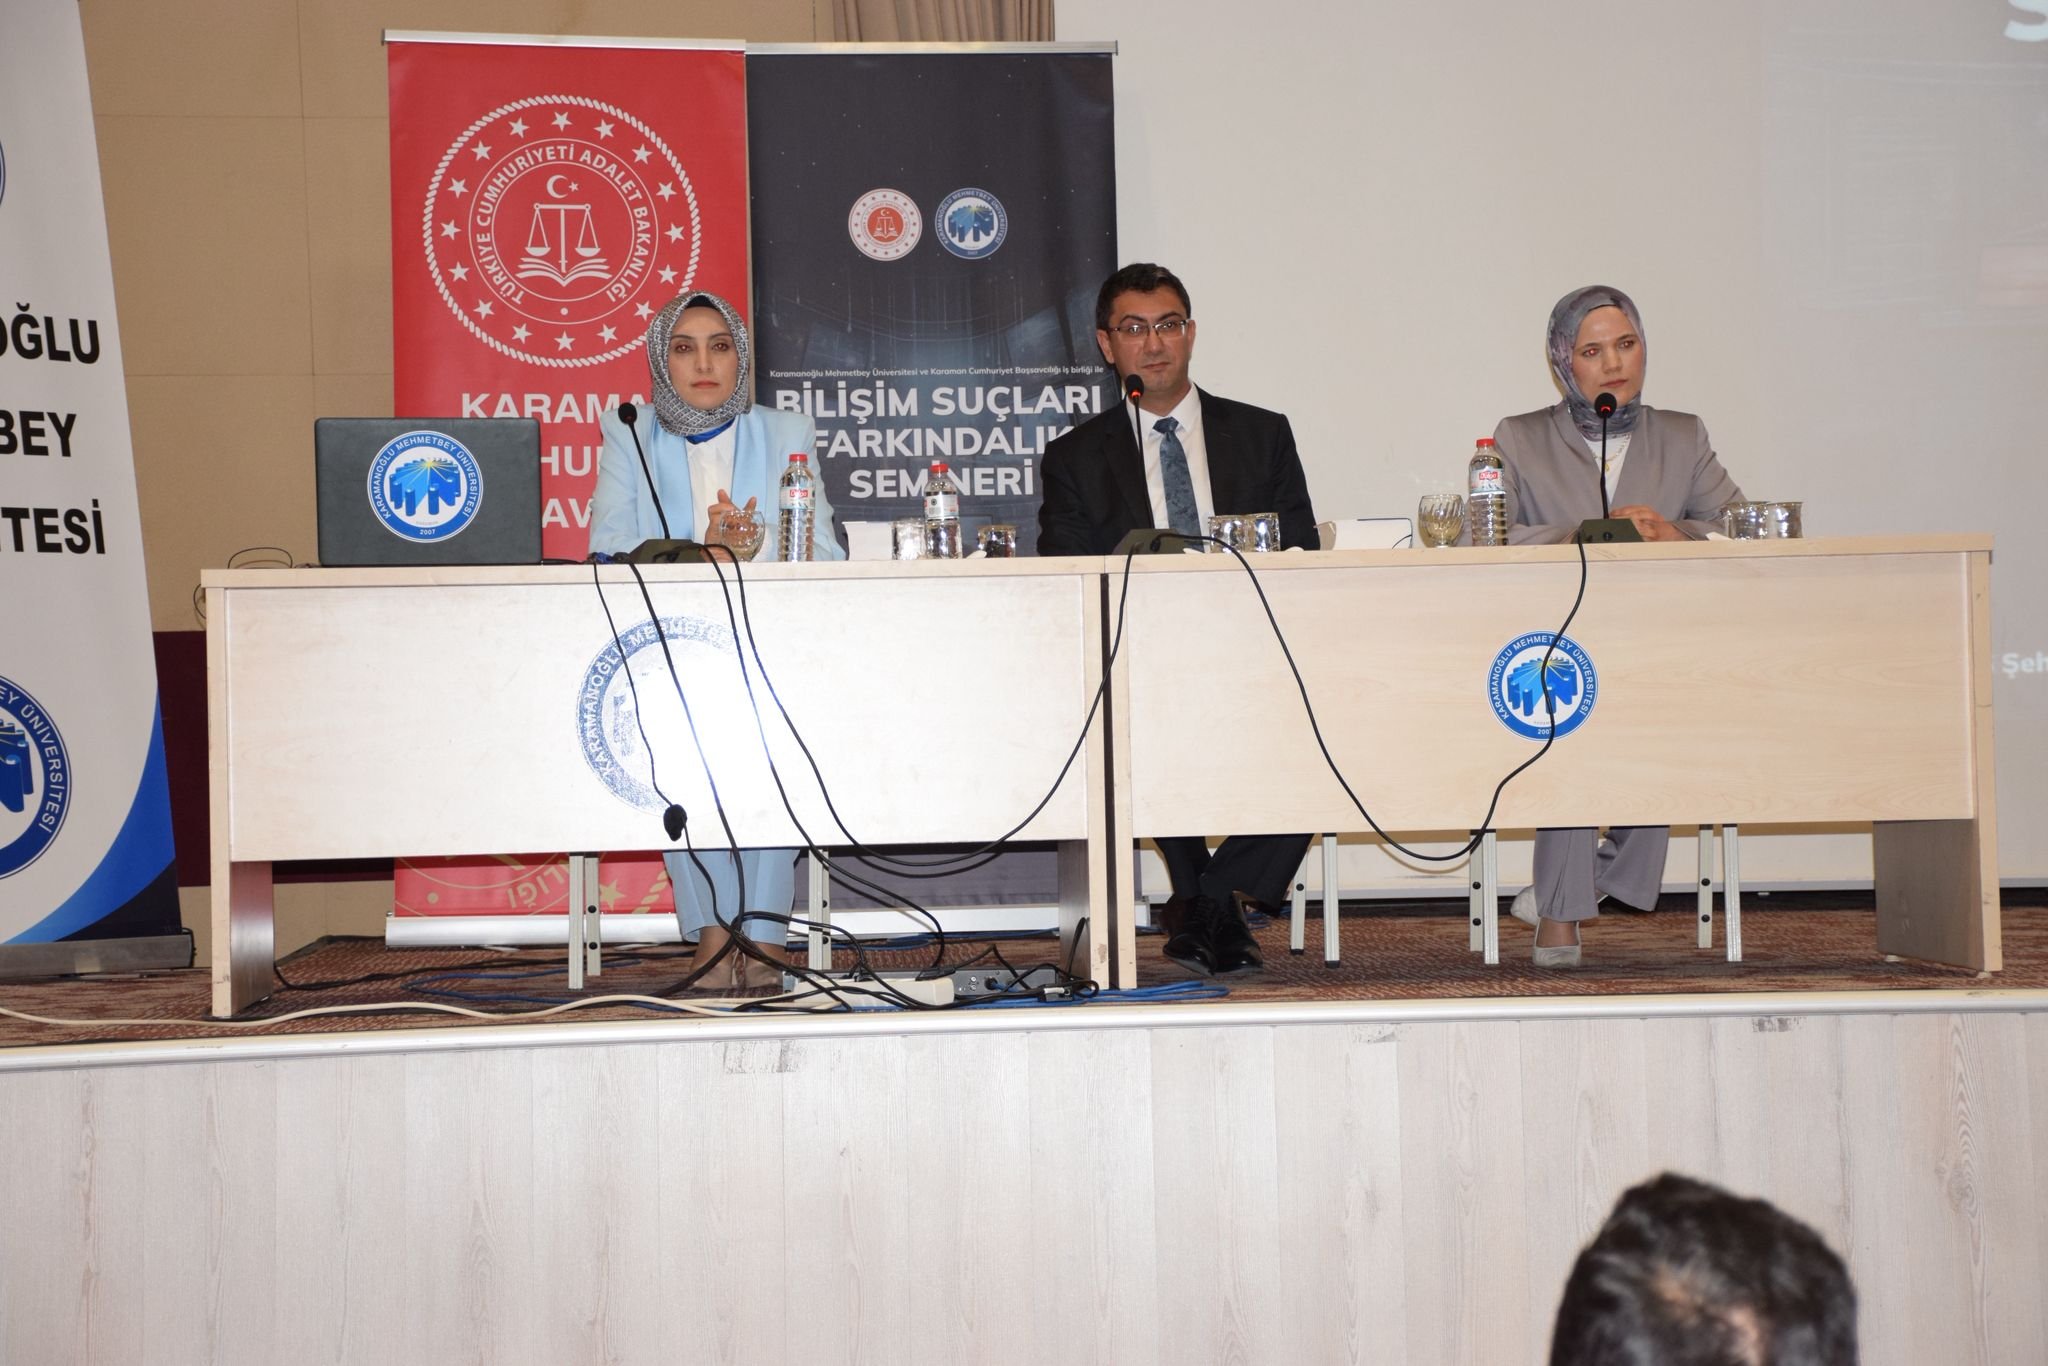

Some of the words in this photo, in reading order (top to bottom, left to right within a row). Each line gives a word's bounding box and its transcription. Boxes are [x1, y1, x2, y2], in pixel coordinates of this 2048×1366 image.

[476, 144, 575, 227] CUMHURİYETİ
[579, 145, 643, 204] ADALET
[476, 232, 526, 304] TÜRKİYE
[606, 205, 652, 302] BAKANLIĞI
[0, 302, 100, 364] ĞLU
[770, 369, 823, 379] Karamanoğlu
[825, 369, 871, 378] Mehmetbey
[872, 368, 917, 377] Üniversitesi
[968, 367, 1013, 376] Cumhuriyet
[1071, 366, 1093, 375] birliği
[1094, 366, 1104, 374] ile
[776, 380, 918, 425] BİLİŞİM
[931, 385, 1101, 422] SUÇLARI
[373, 450, 396, 519] KARAMANOĞLU
[395, 436, 457, 451] MEHMETBEY
[850, 458, 1034, 498] SEMNERİ
[0, 499, 106, 554] TESİ
[1491, 650, 1513, 719] KARAMANOĞLU
